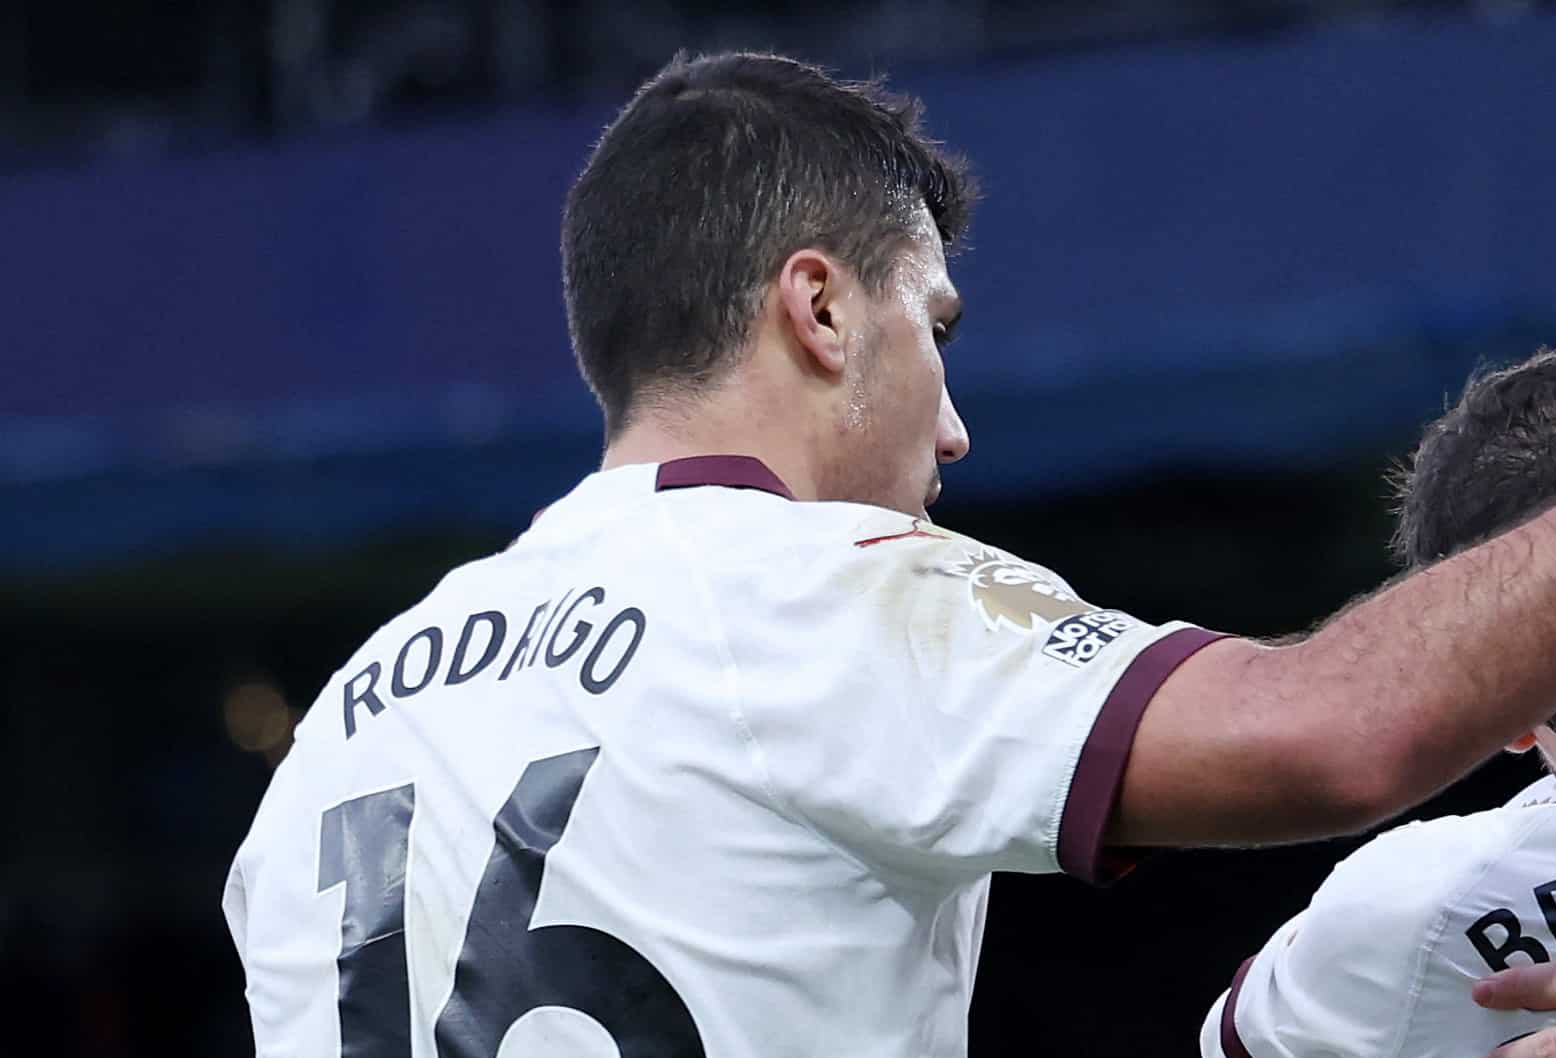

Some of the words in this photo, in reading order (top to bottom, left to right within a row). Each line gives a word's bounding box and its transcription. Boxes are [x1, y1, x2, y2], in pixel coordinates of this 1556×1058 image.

[1043, 623, 1088, 661] No
[1065, 631, 1107, 667] for
[344, 586, 646, 740] RODRIGO
